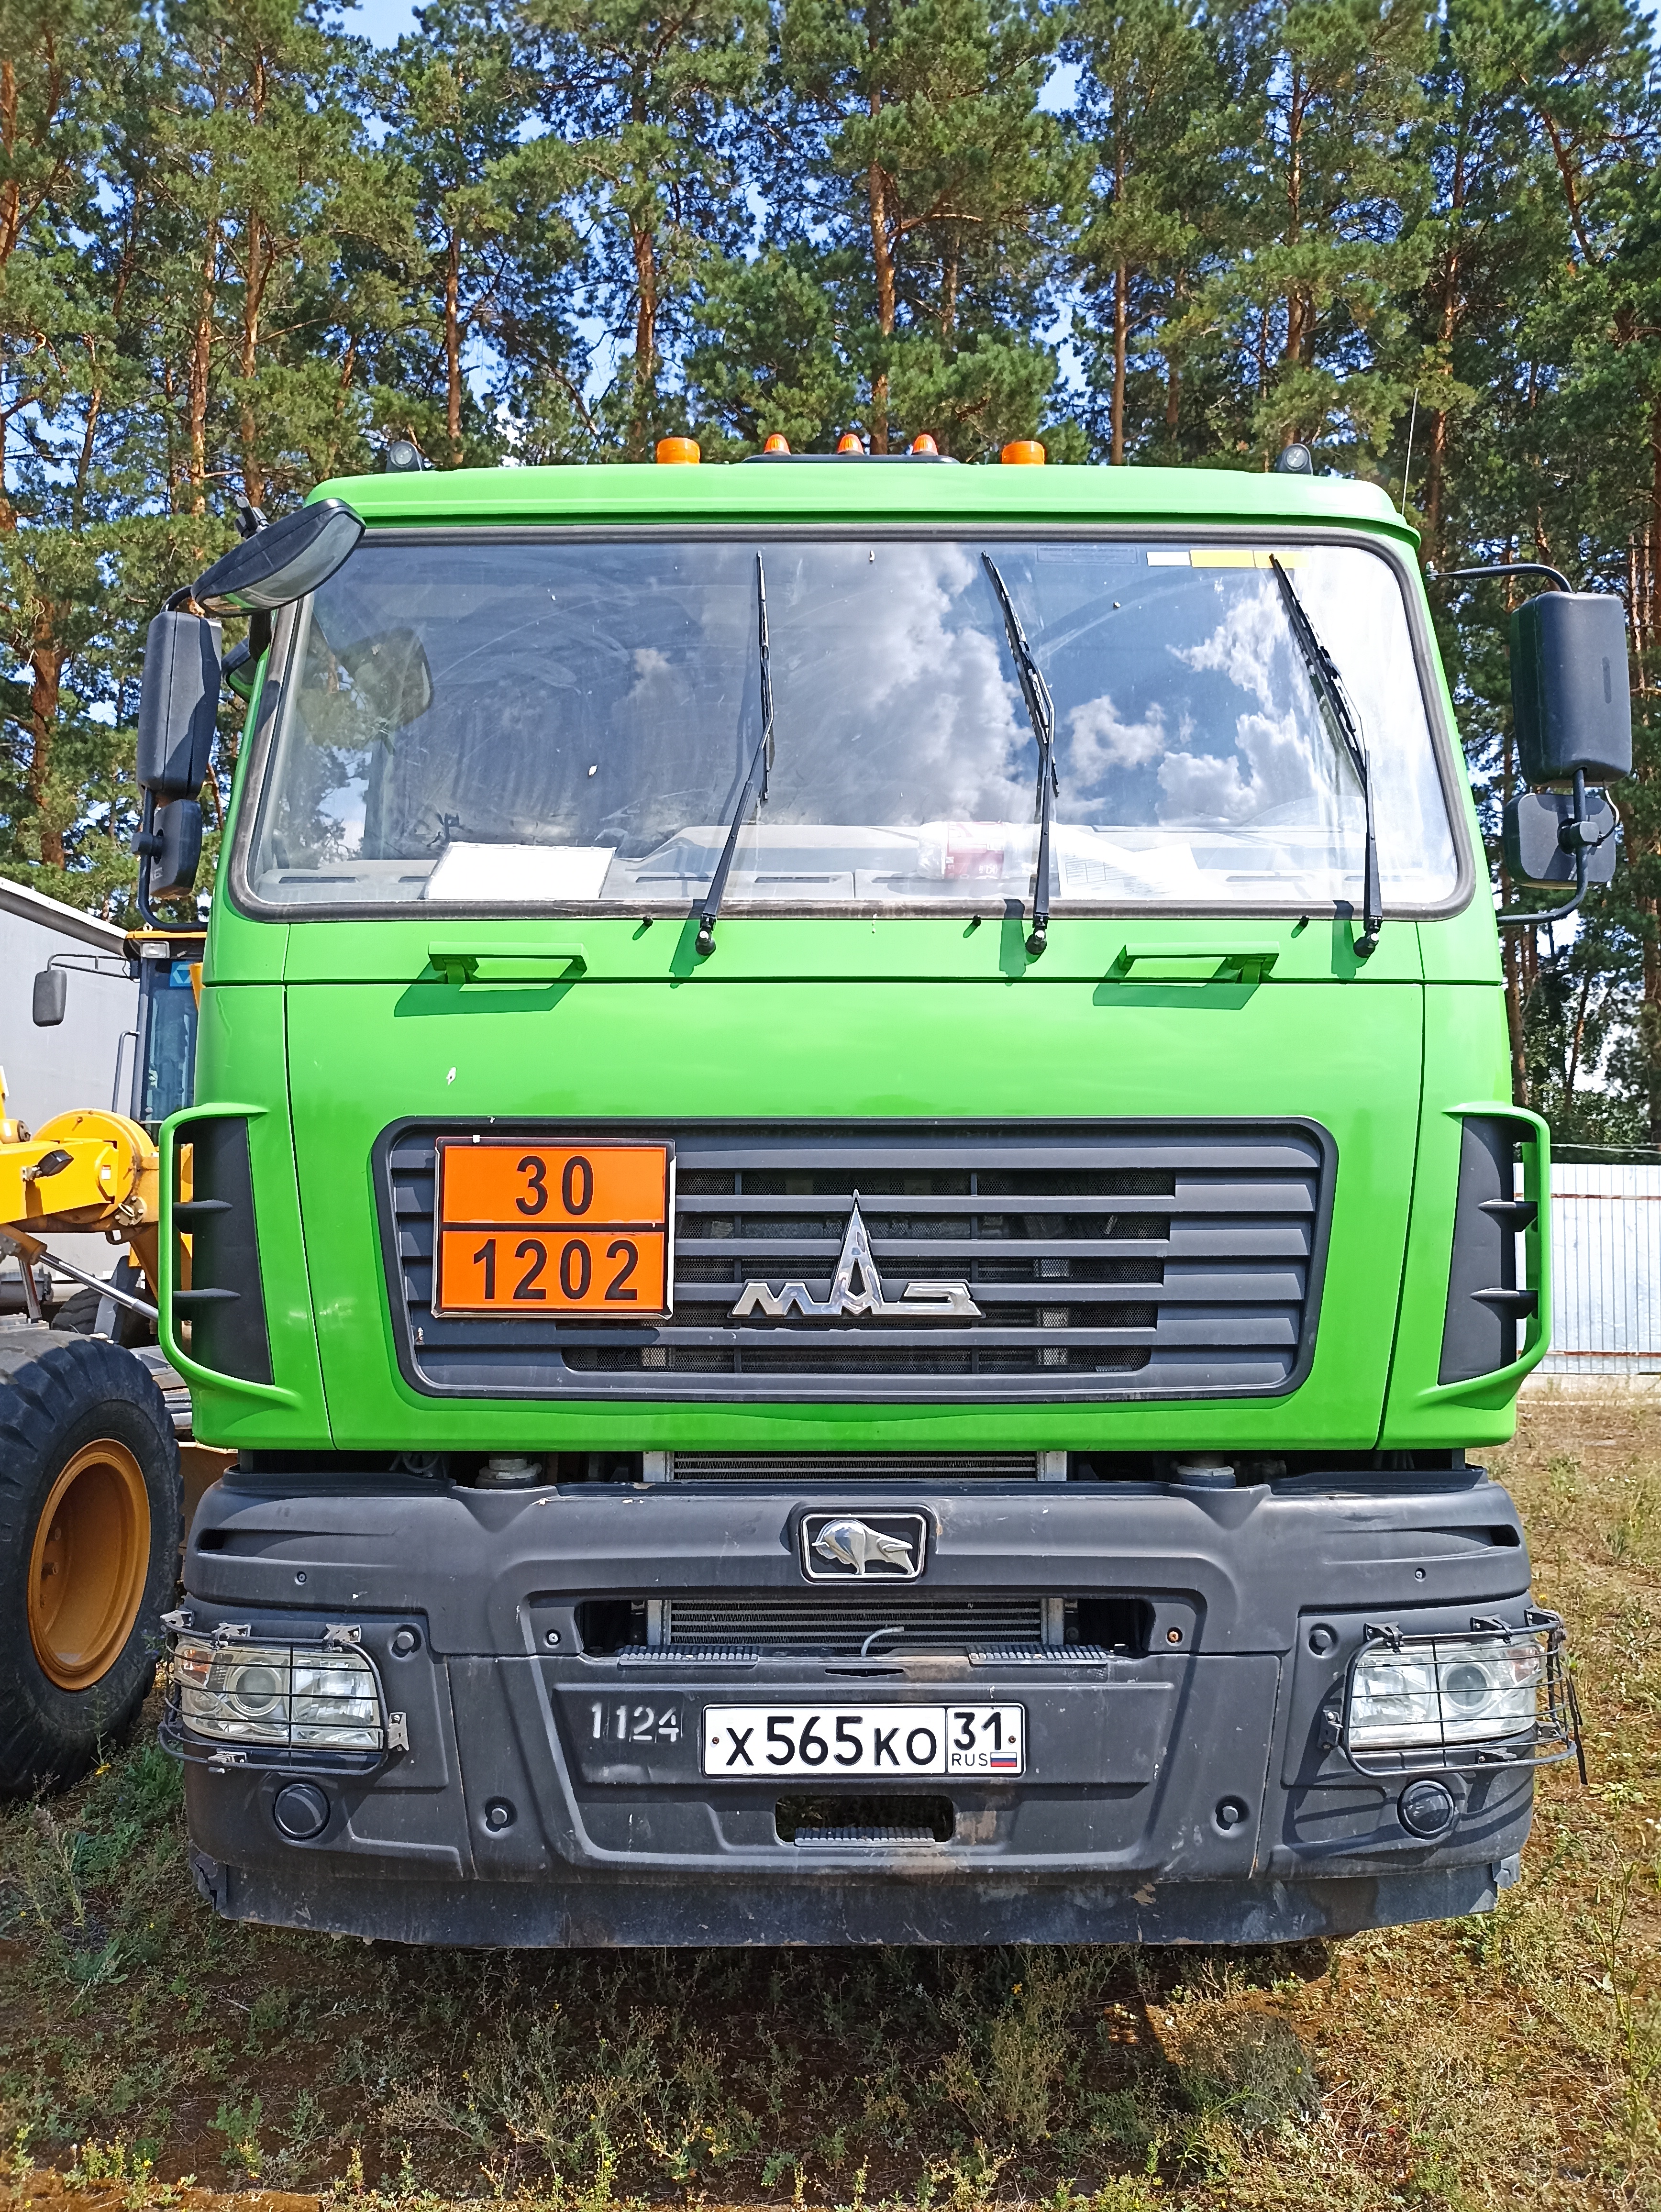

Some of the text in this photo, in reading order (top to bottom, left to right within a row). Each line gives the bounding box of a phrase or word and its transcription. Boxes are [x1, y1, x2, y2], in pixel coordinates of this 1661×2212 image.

[516, 1155, 594, 1216] 30
[473, 1238, 638, 1300] 1202
[591, 1703, 679, 1742] 1124
[953, 1712, 1001, 1751] 31
[952, 1753, 988, 1767] RUS
